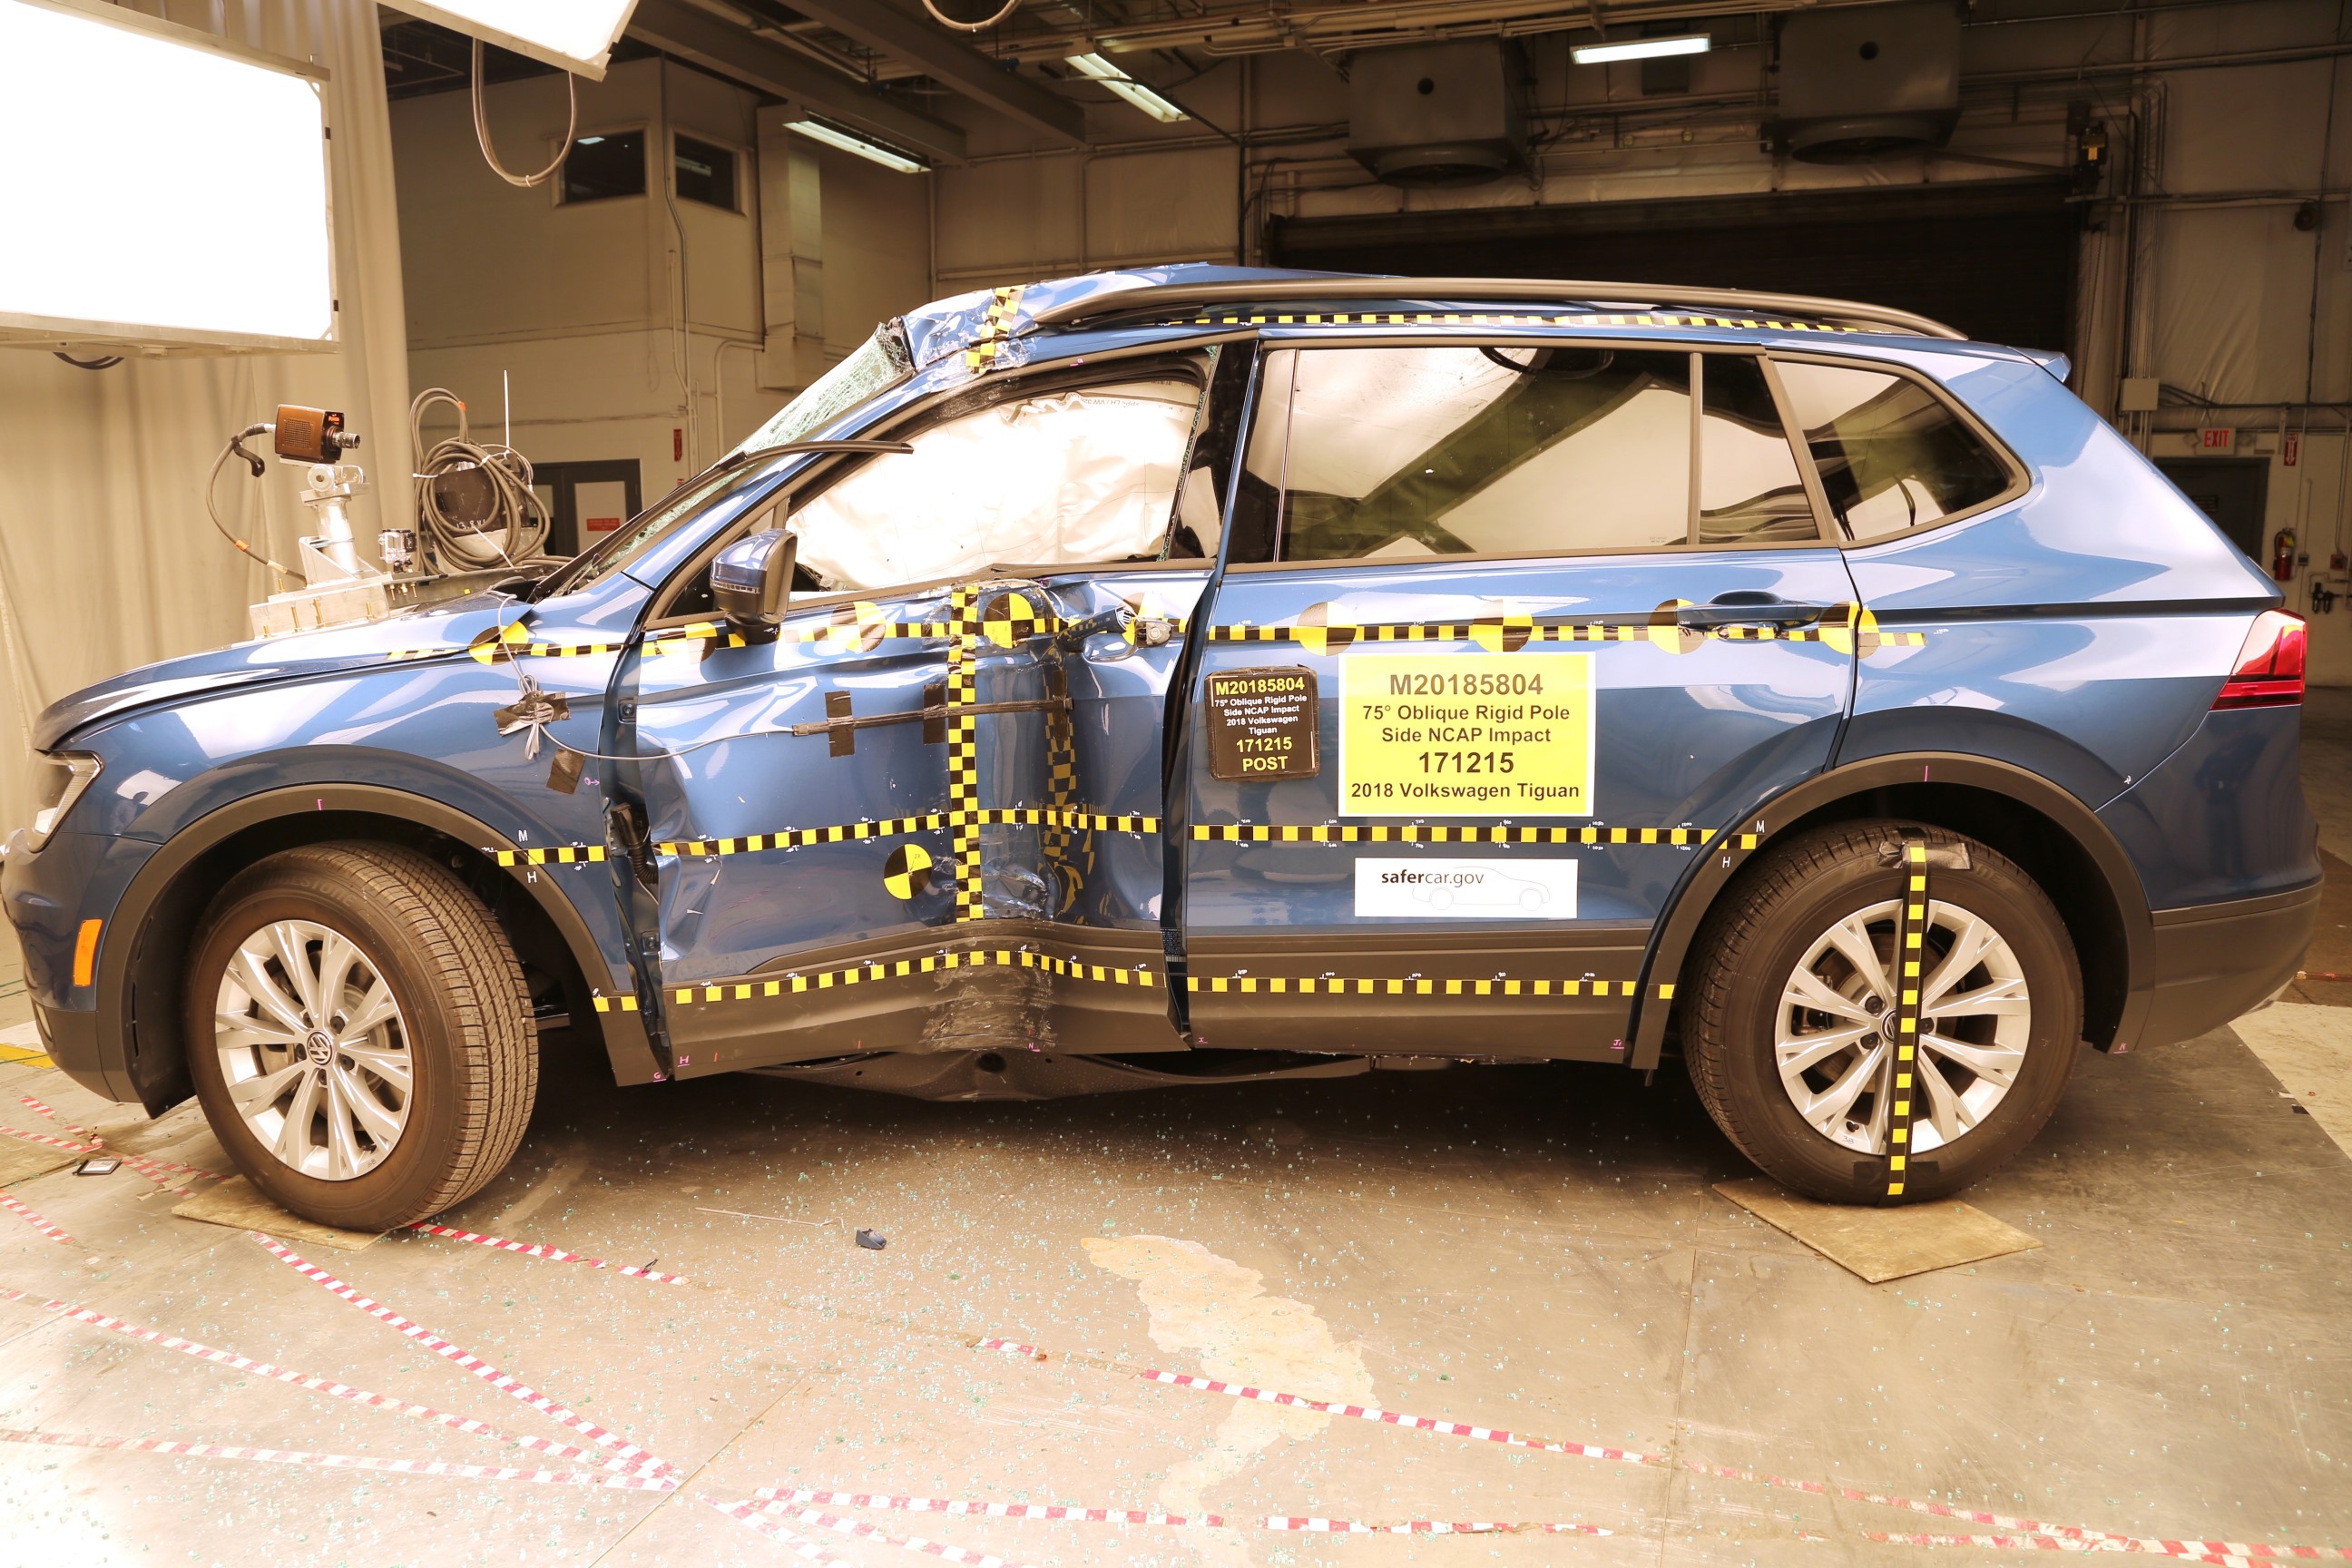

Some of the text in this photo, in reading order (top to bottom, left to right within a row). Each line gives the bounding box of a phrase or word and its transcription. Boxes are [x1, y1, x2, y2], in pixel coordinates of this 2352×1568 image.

[2204, 428, 2231, 448] EXIT
[1215, 676, 1305, 696] M20185804
[1389, 673, 1544, 696] M20185804
[1230, 698, 1263, 707] Oblique
[1264, 695, 1287, 705] Rigid
[1289, 694, 1307, 702] Pole
[1223, 704, 1299, 717] Side NCAP Impact
[1397, 704, 1469, 723] Oblique
[1475, 704, 1524, 723] Rigid
[1530, 704, 1570, 720] Pole
[1226, 715, 1298, 727] 2018 Volkswagen
[1249, 727, 1278, 736] Tiguan
[1381, 727, 1551, 746] Side NCAP Impact
[1236, 736, 1293, 753] 171215
[1242, 755, 1289, 772] POST
[1418, 751, 1514, 774] 171215
[1351, 782, 1580, 801] 2018 Volkswagen Tiguan
[1756, 820, 1765, 833] M
[518, 829, 529, 843] M
[1722, 857, 1731, 868] H
[527, 871, 538, 884] H
[1381, 868, 1485, 888] safercar.gov
[680, 1055, 690, 1065] H
